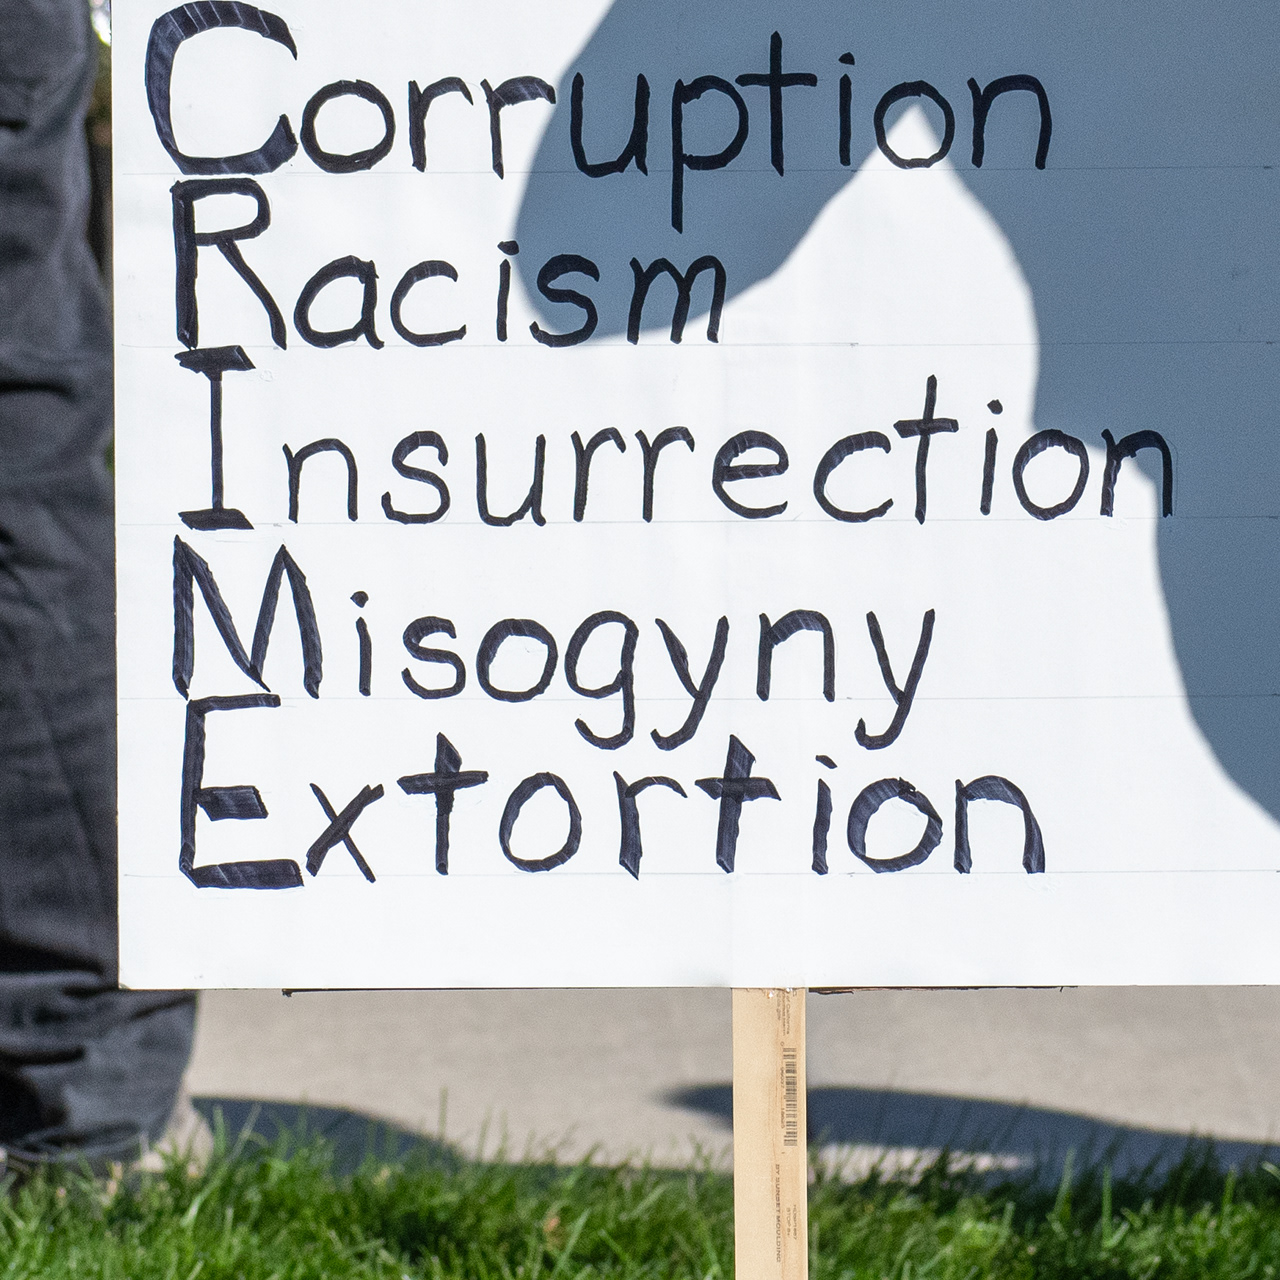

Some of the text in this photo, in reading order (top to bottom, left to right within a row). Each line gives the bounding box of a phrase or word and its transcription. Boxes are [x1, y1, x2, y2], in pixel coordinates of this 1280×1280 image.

[145, 0, 1052, 233] Corruption
[171, 177, 727, 350] Racism
[174, 345, 1174, 531] Insurrection
[173, 534, 936, 751] Misogyny
[179, 693, 1046, 889] Extortion
